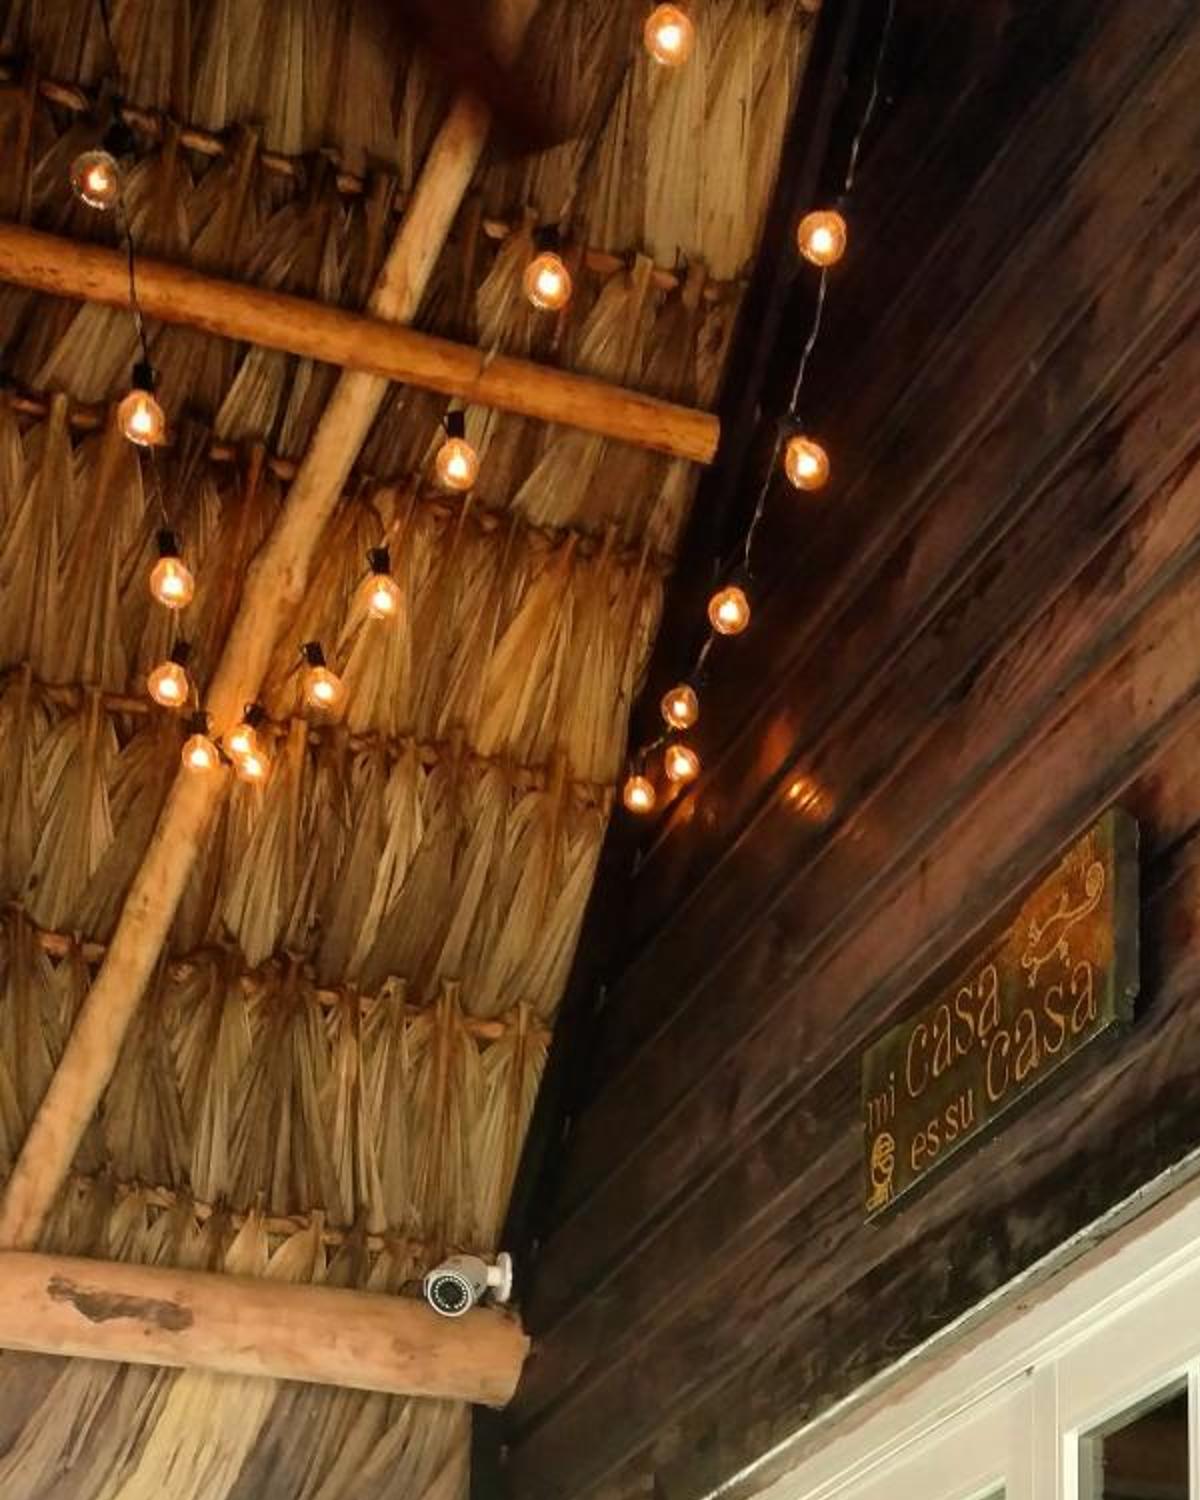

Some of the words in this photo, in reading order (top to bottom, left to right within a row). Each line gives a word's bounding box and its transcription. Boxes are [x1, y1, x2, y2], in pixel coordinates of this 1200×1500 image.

[867, 1071, 896, 1134] mi
[911, 1119, 941, 1171] es
[944, 1087, 975, 1141] su
